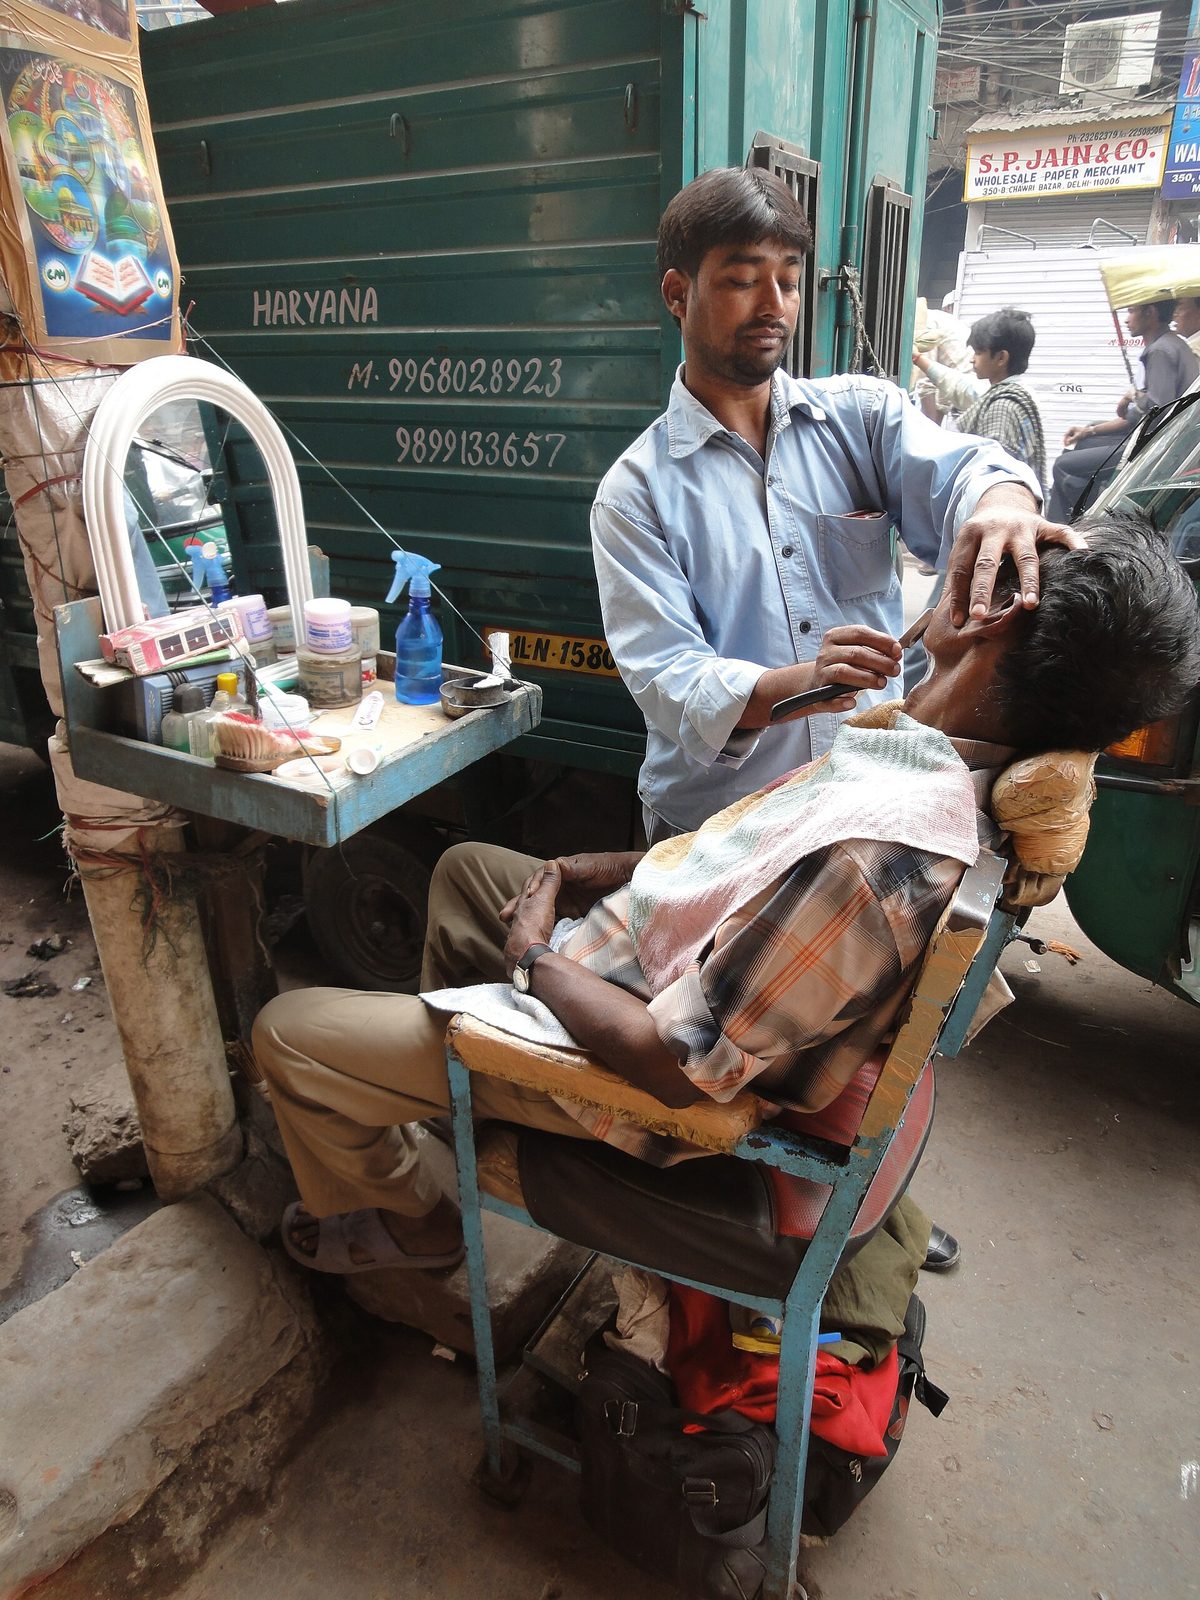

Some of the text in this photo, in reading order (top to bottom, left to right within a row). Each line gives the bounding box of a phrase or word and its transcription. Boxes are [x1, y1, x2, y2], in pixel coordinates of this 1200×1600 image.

[1026, 144, 1093, 170] JAIN
[974, 162, 1146, 187] WHOLESALE PAPER MERCHANT
[1008, 184, 1035, 194] CHAWRI
[1093, 177, 1120, 186] 110006
[252, 286, 378, 326] HARYANA
[388, 356, 563, 398] 9968028923
[1059, 384, 1083, 393] CNG
[395, 426, 567, 468] 9899133657
